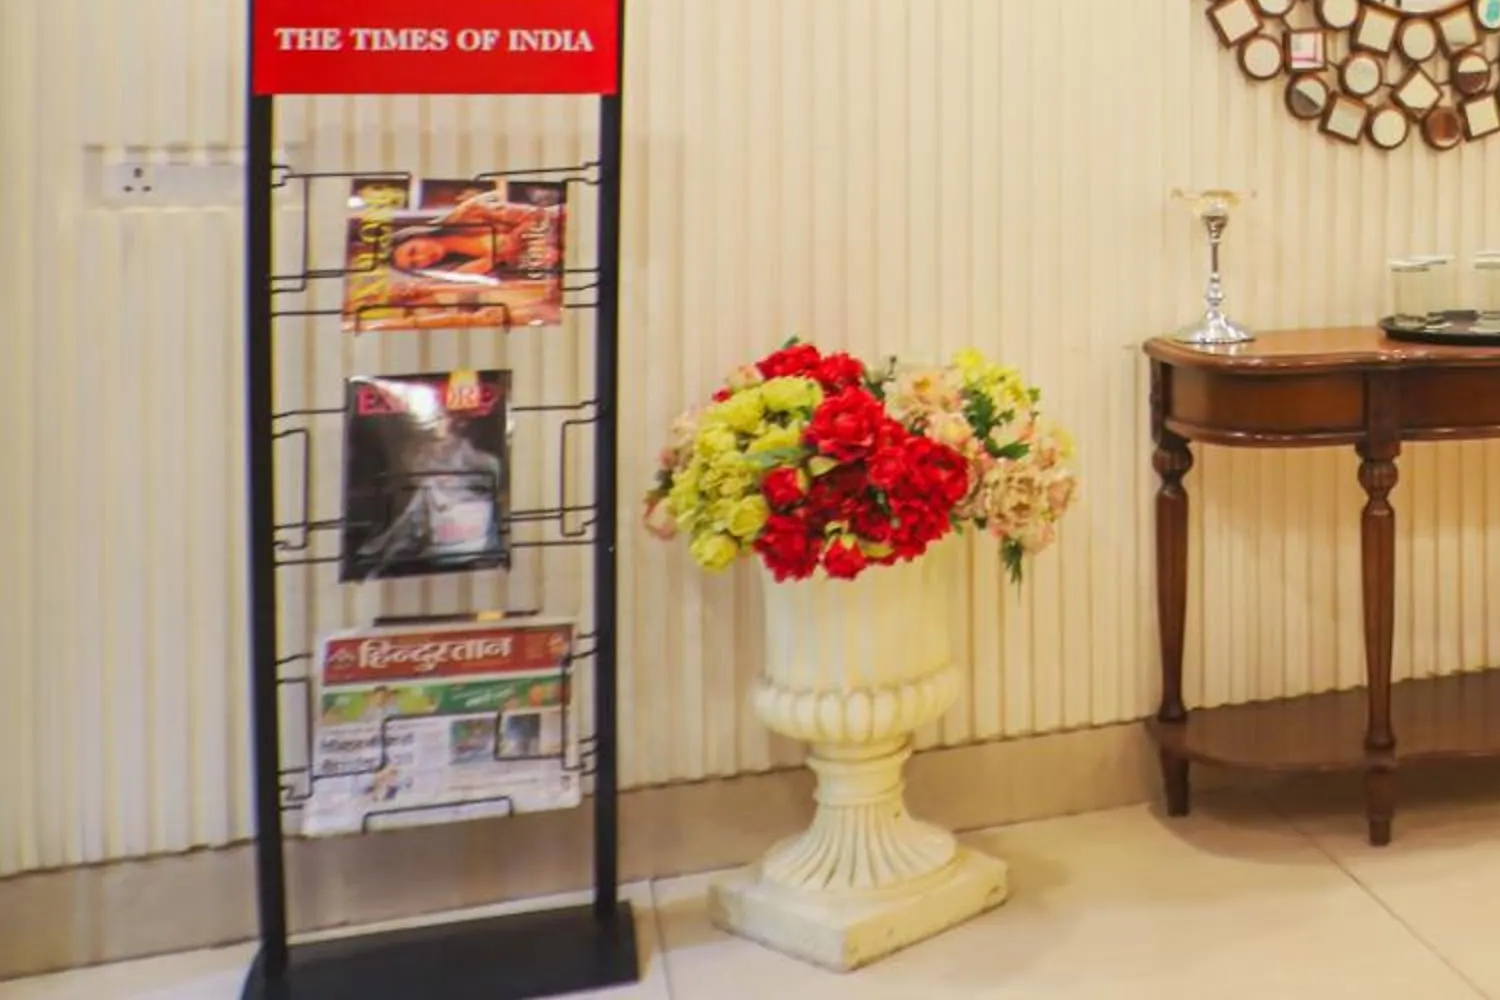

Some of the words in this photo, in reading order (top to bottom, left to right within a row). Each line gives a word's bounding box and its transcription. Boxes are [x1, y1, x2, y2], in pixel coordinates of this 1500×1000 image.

[275, 27, 342, 51] THE
[349, 27, 448, 52] TIMES
[456, 28, 500, 52] OF
[507, 28, 594, 53] INDIA
[358, 637, 512, 671] हिन्दुस्तान
